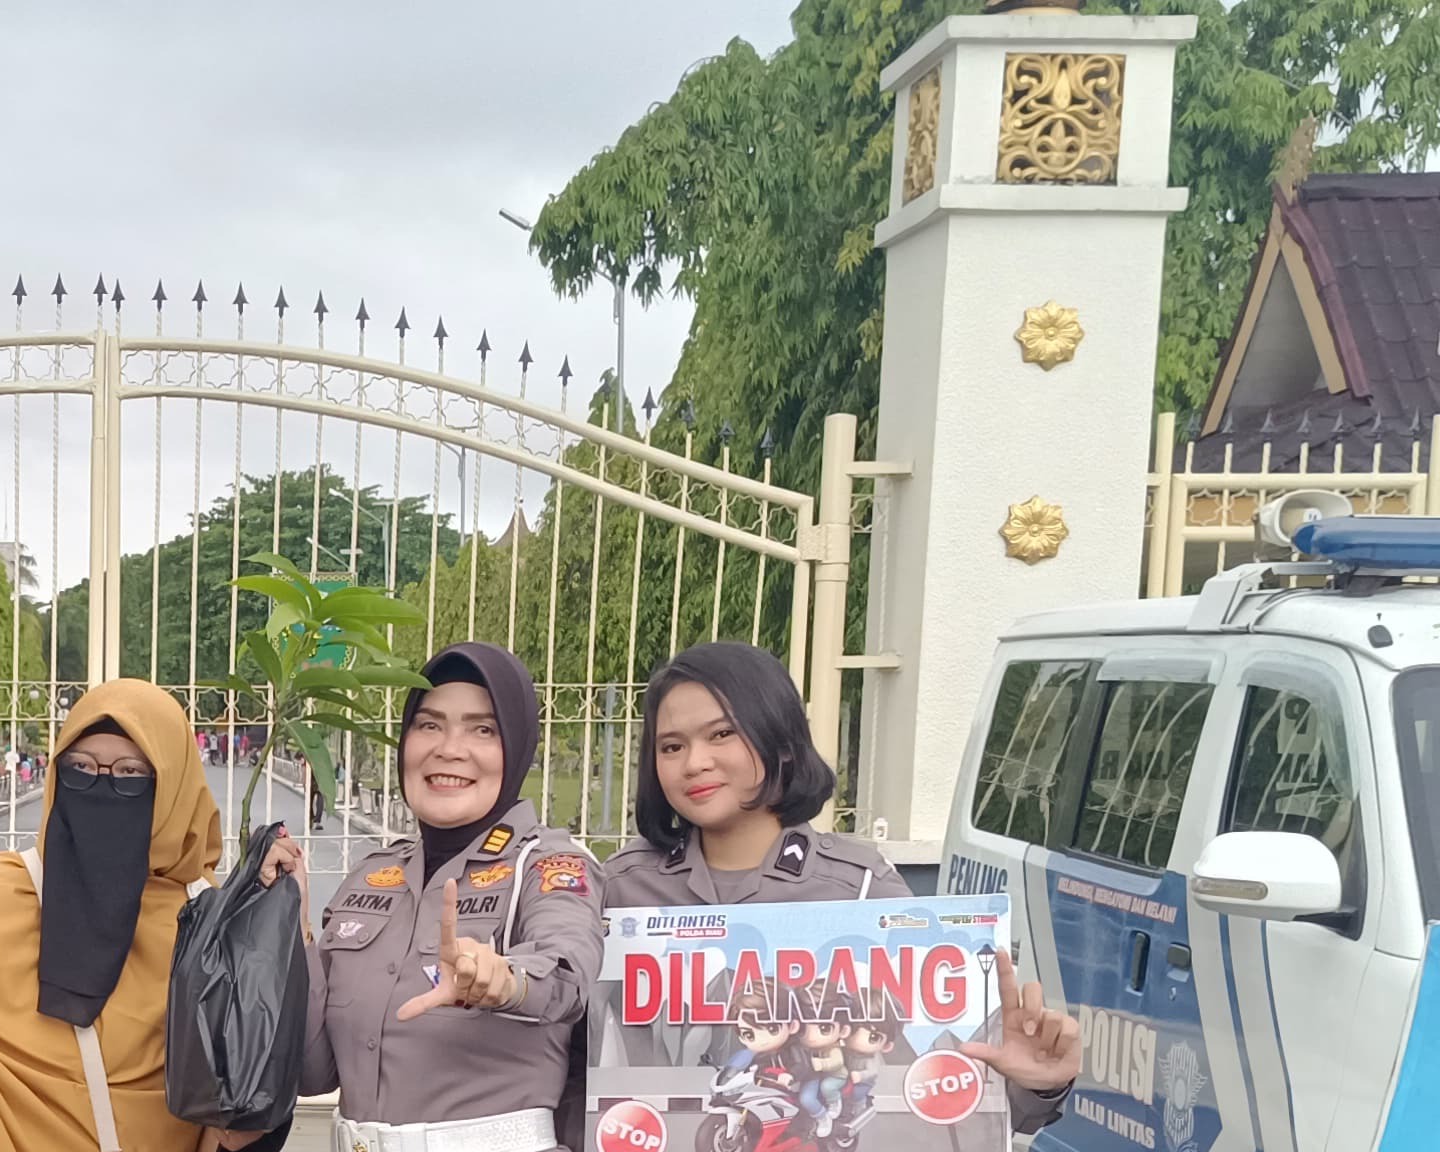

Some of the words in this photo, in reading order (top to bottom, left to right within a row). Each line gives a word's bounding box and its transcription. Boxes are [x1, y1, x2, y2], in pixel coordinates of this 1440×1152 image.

[342, 893, 394, 912] RATNA
[646, 914, 727, 929] DITLANTAS
[622, 944, 968, 1025] DILARANG
[1077, 1004, 1157, 1106] POLISI
[910, 1071, 975, 1100] STOP
[602, 1118, 661, 1151] STOP
[1074, 1093, 1105, 1126] LALU
[1107, 1109, 1155, 1150] LINTAS
